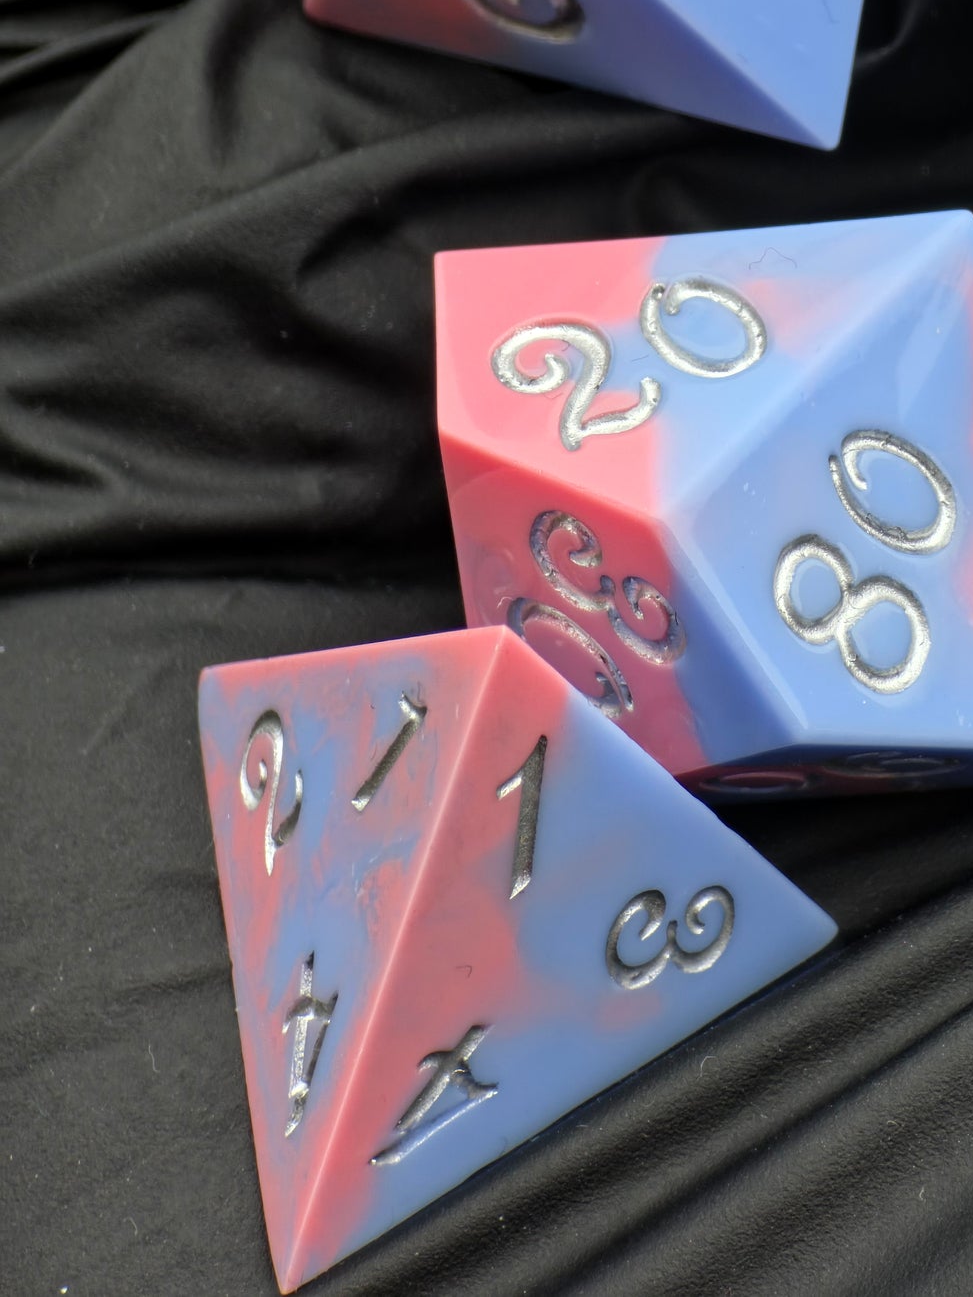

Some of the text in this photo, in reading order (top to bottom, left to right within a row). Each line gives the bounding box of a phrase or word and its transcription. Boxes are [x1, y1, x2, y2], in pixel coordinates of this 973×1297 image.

[490, 274, 768, 451] 20
[773, 428, 957, 695] 80
[239, 708, 303, 877] 2
[348, 688, 428, 812] 1
[496, 734, 547, 900] 1
[604, 884, 736, 992] 3
